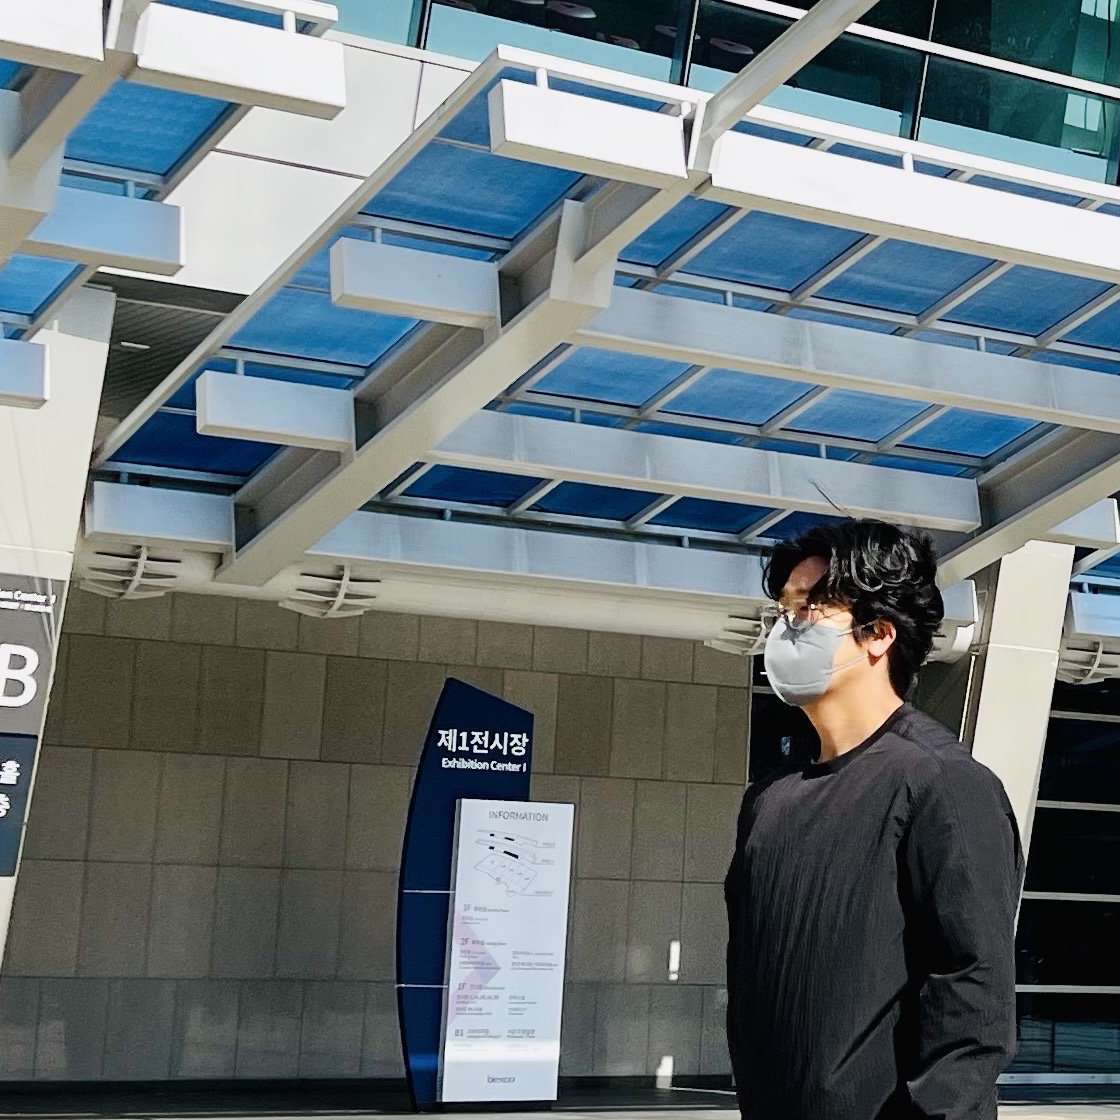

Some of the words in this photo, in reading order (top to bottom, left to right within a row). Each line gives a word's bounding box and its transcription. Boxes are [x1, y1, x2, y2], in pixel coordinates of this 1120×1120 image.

[0, 643, 39, 707] B
[437, 729, 529, 756] 제1전시장
[441, 757, 489, 770] Exhibition
[490, 760, 522, 772] Center
[488, 811, 549, 822] INFORMATION
